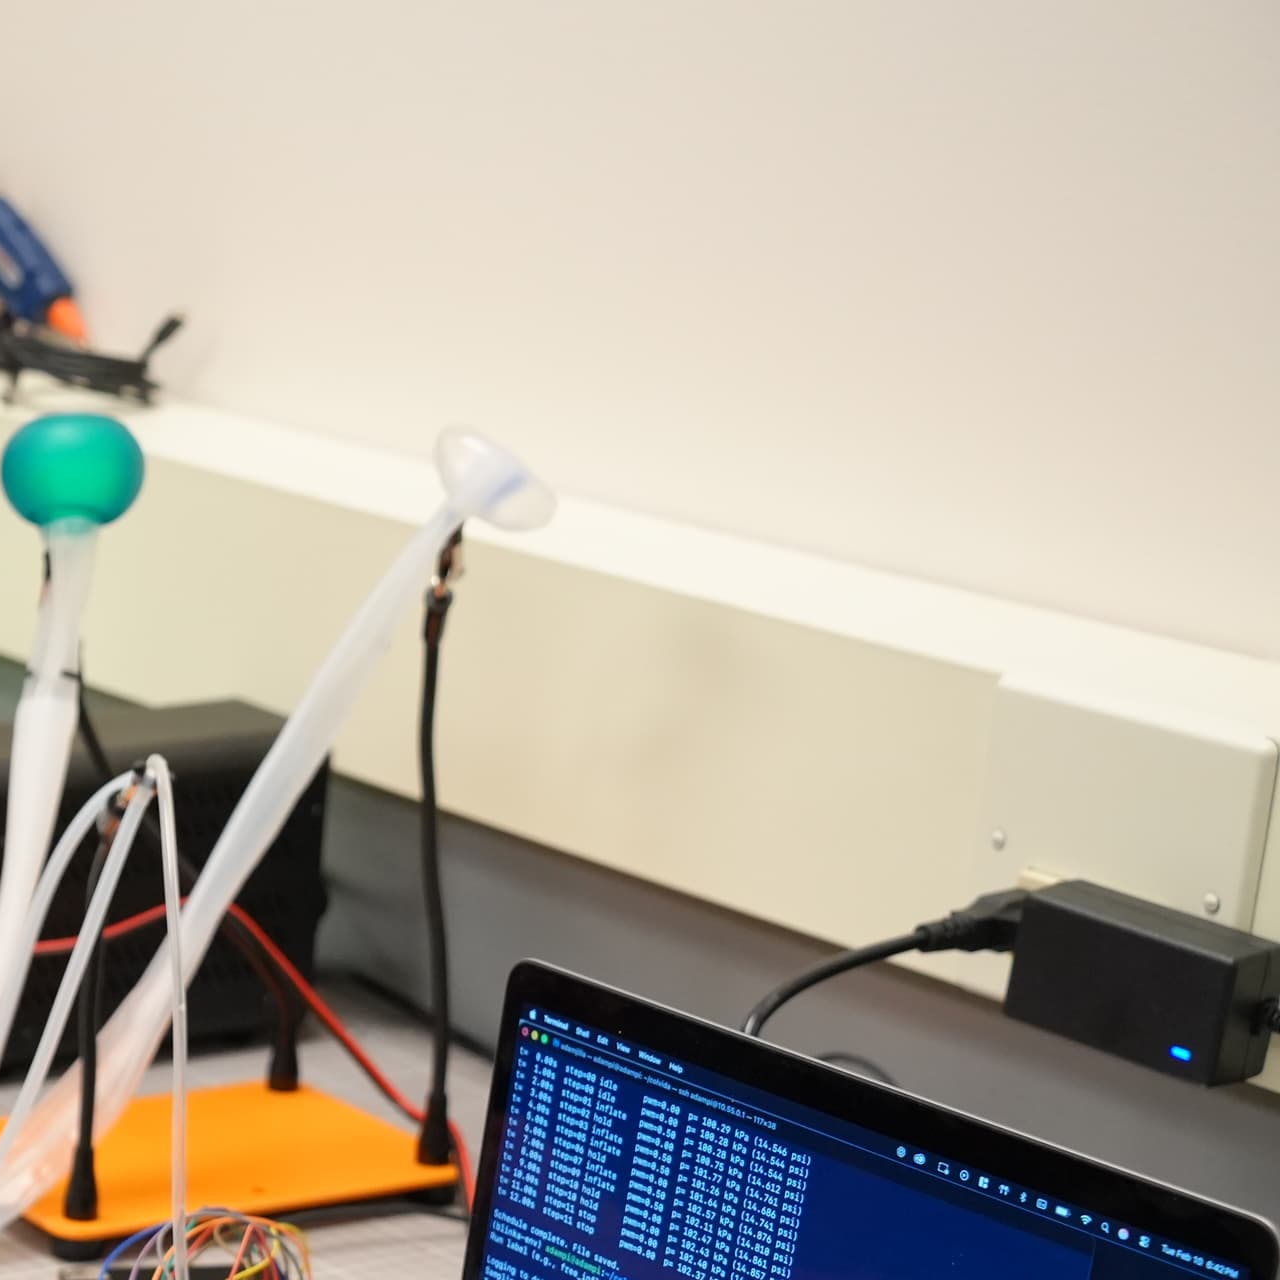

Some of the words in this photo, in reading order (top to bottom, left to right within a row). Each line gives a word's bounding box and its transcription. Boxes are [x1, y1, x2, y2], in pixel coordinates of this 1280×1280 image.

[544, 1014, 568, 1030] Terminal
[596, 1034, 608, 1045] Edit
[616, 1042, 630, 1053] View
[638, 1050, 661, 1064] Window
[668, 1062, 683, 1073] Help
[599, 1076, 617, 1091] idle
[702, 1116, 731, 1134] 100.29
[734, 1128, 749, 1142] kPa
[754, 1136, 787, 1156] (14.546
[790, 1152, 811, 1166] psi)
[588, 1148, 606, 1163] hold
[689, 1190, 717, 1208] 101.64
[721, 1202, 736, 1216] kPa
[741, 1210, 773, 1231] (14.741
[777, 1227, 797, 1241] psi)
[487, 1255, 516, 1276] Logging
[520, 1270, 528, 1280] to
[490, 1231, 503, 1244] Run
[507, 1238, 527, 1255] label
[494, 1208, 527, 1230] Schedule
[531, 1226, 567, 1248] complete.
[573, 1243, 590, 1257] File
[594, 1254, 619, 1270] saved.
[576, 1221, 594, 1234] stop
[677, 1263, 705, 1280] 102.37
